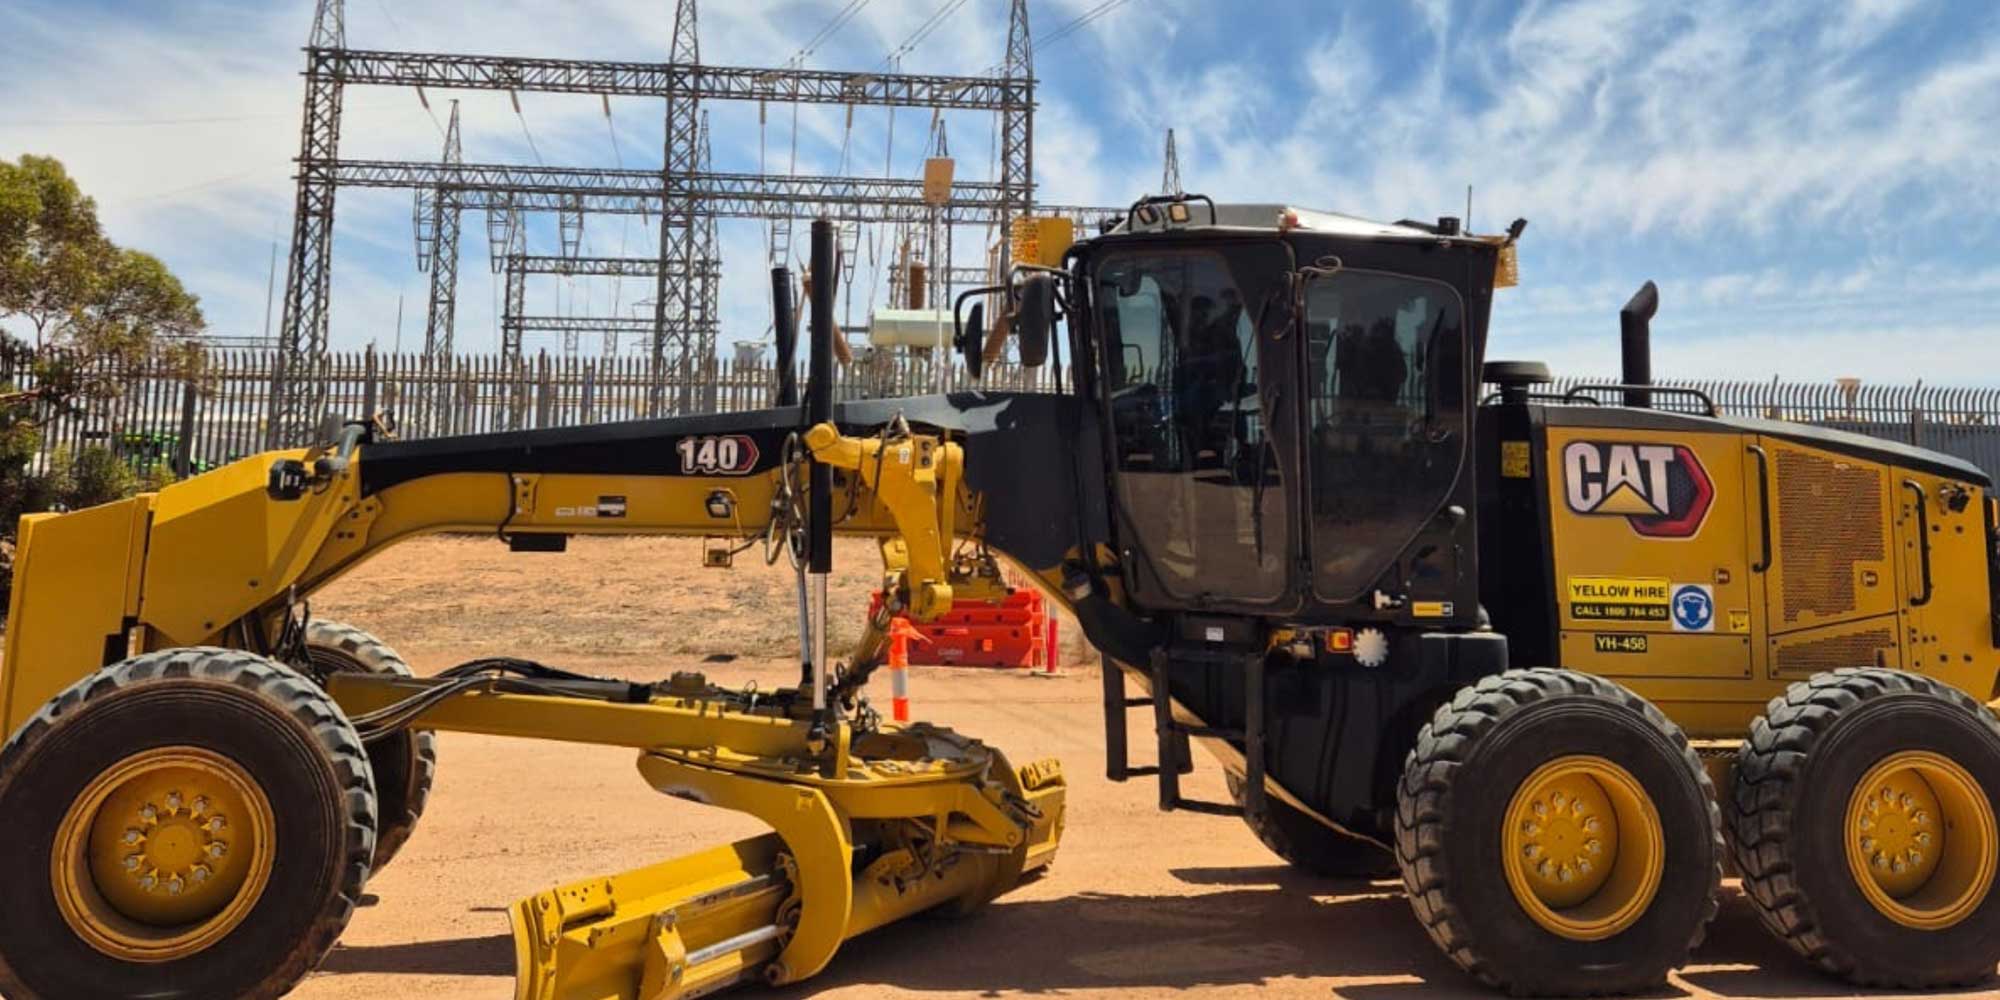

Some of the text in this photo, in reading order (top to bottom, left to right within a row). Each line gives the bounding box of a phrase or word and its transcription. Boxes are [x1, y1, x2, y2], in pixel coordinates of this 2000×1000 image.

[680, 438, 738, 470] 140
[1565, 442, 1674, 515] CAT
[1572, 585, 1666, 598] YELLOW HIRE
[1575, 605, 1602, 616] CALL
[1597, 636, 1647, 650] YH-458
